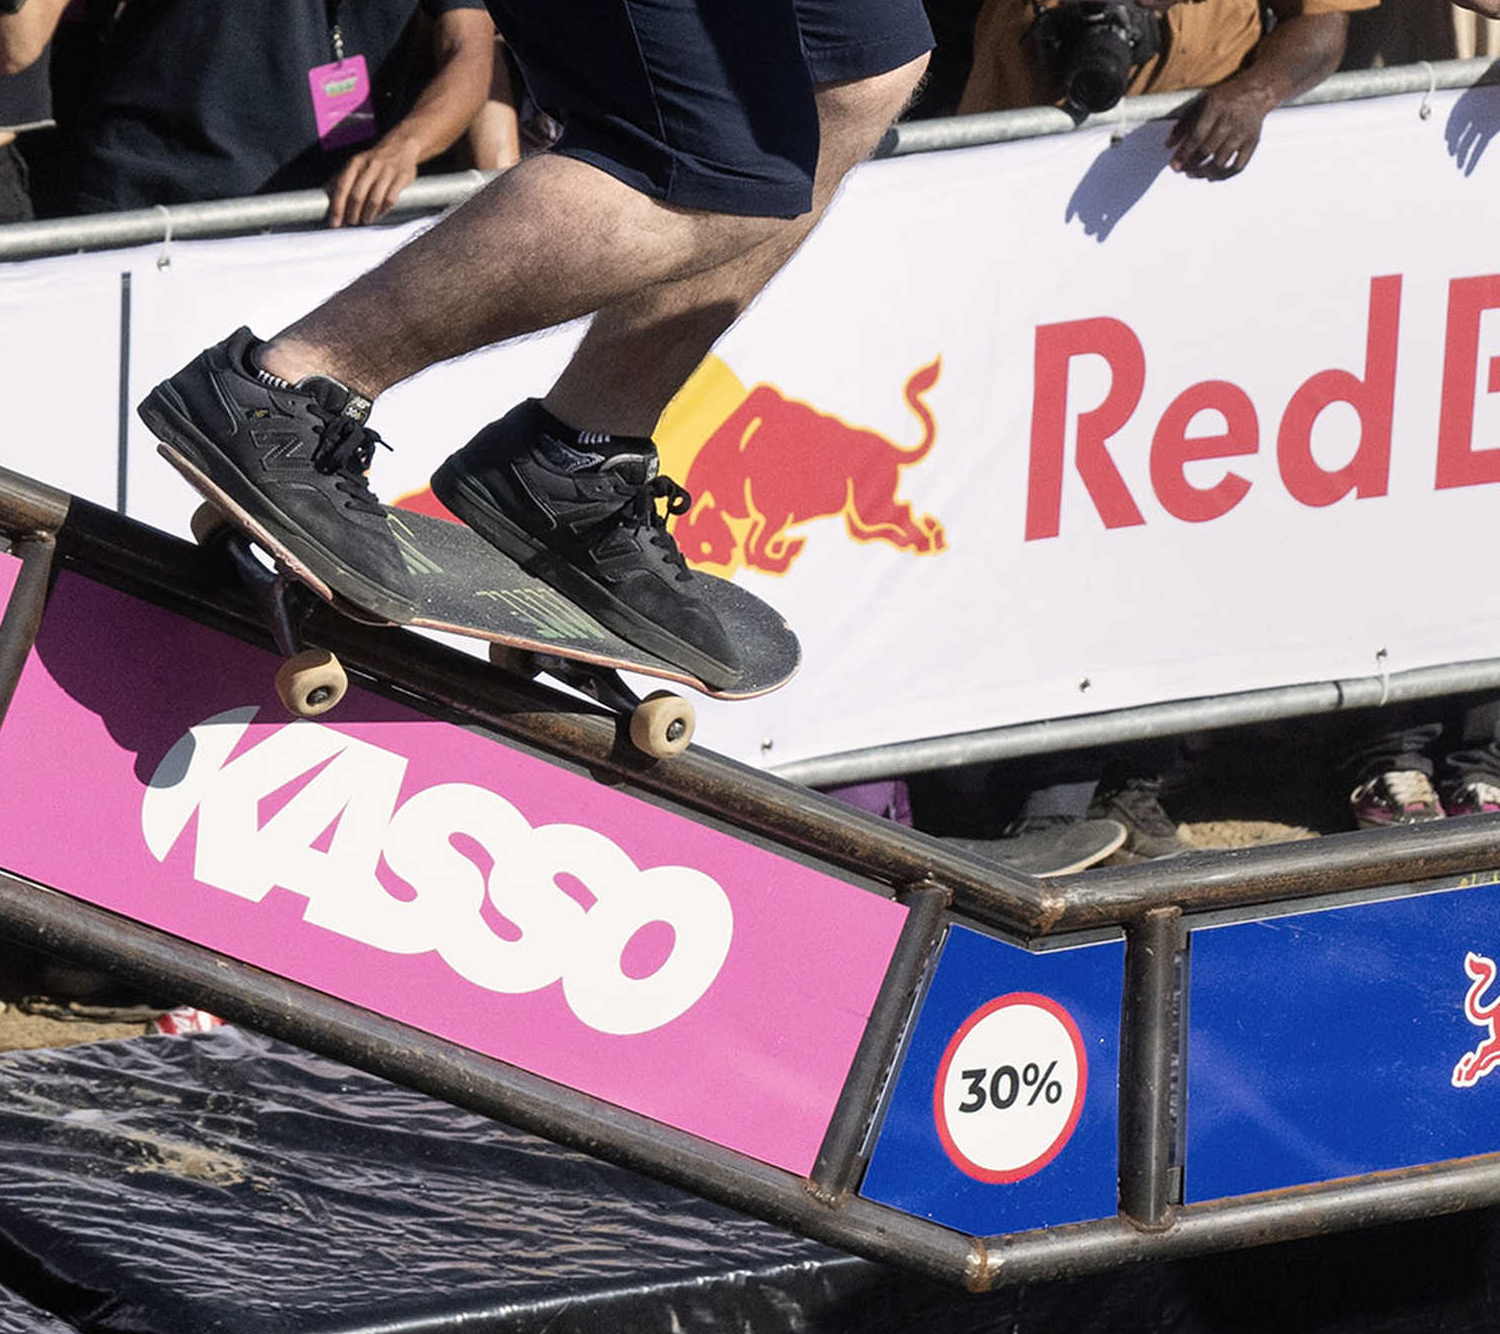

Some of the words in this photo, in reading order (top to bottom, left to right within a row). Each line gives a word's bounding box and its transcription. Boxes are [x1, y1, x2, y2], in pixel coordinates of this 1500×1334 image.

[1024, 273, 1404, 543] Red
[142, 705, 734, 1036] KASSO
[958, 1061, 1064, 1114] 30%
